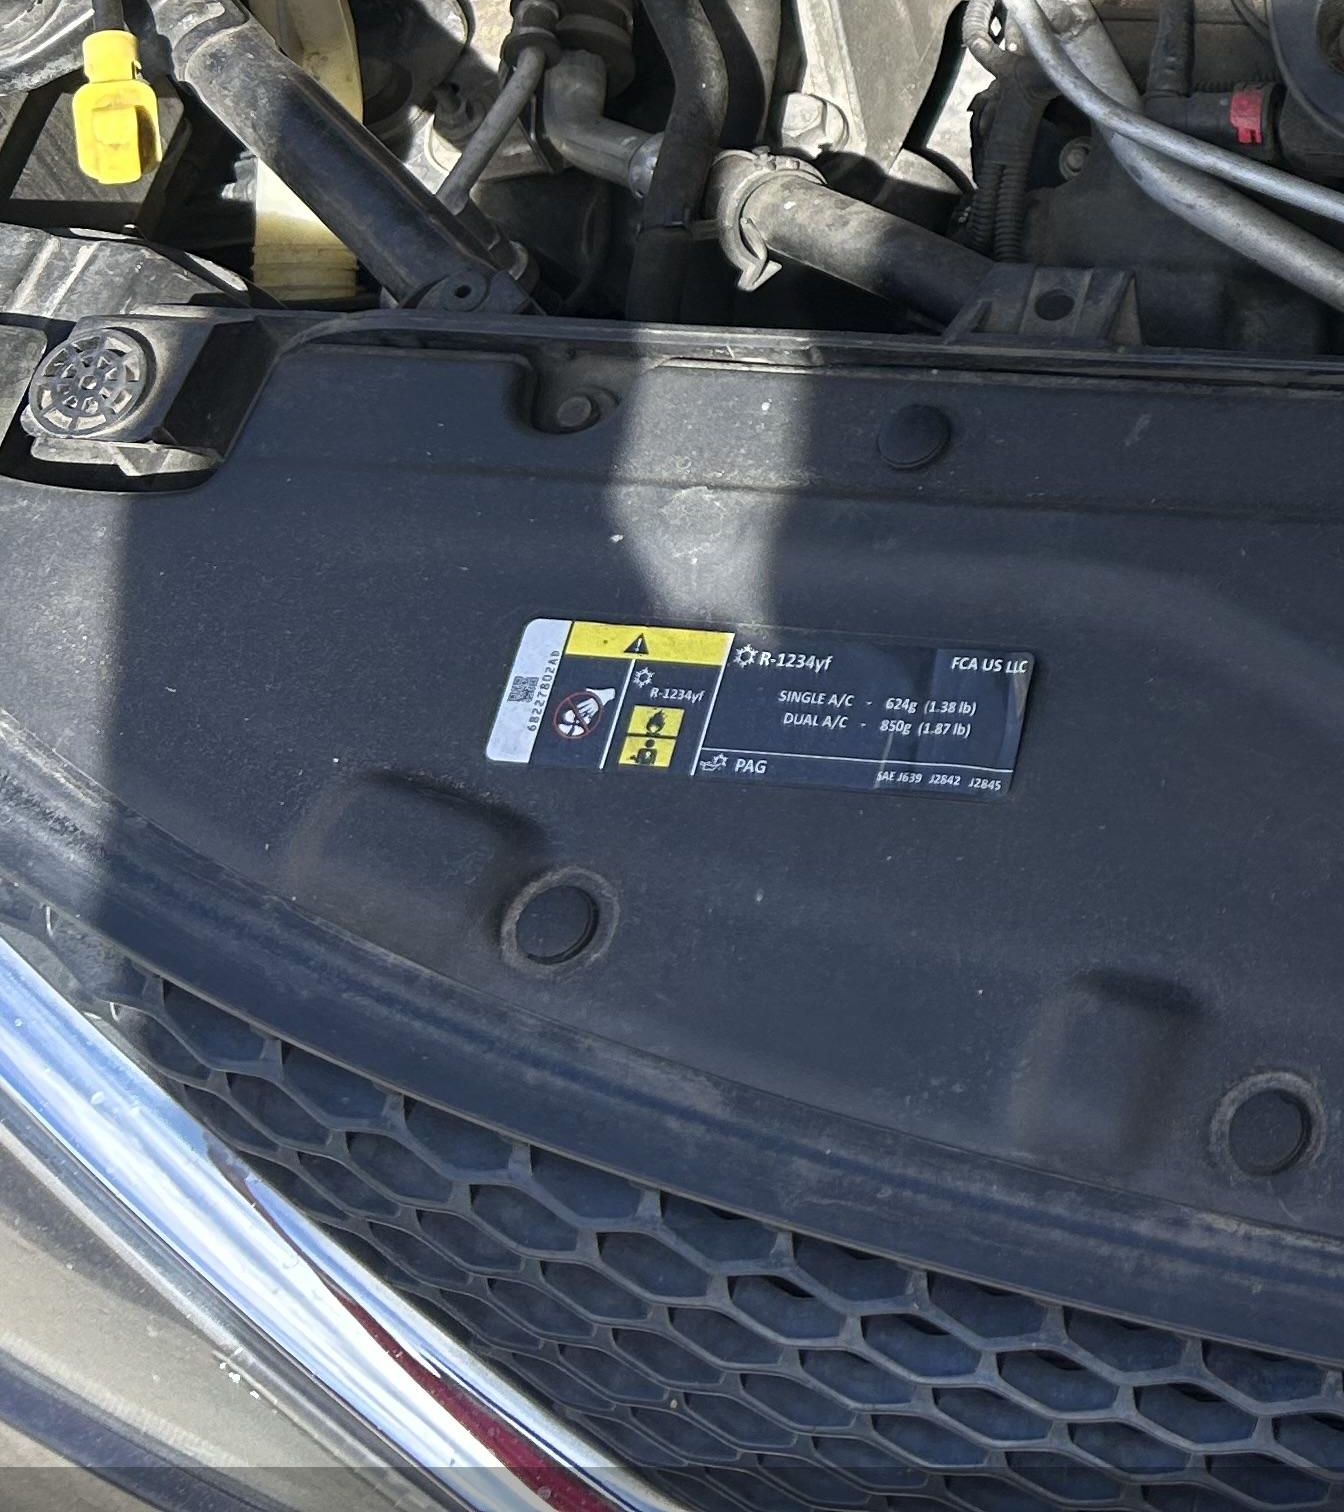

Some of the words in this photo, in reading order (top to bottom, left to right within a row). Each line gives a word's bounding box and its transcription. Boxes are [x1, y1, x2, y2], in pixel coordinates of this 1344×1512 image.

[759, 651, 835, 675] R-1234yf
[951, 656, 978, 672] FCA
[982, 658, 1003, 672] US
[1005, 659, 1029, 674] LLC
[649, 687, 706, 704] R-1234yf
[778, 690, 826, 705] SINGLE
[827, 692, 855, 708] A/C
[885, 697, 918, 715] 624g
[923, 700, 957, 716] (1.38
[958, 700, 977, 717] lb)
[783, 712, 820, 727] DUAL
[822, 714, 849, 730] A/C
[879, 719, 912, 737] 850g
[917, 721, 951, 737] (1.87
[952, 722, 971, 739] lb)
[734, 759, 768, 775] PAG
[876, 770, 896, 783] SAE
[896, 772, 923, 785] J639
[928, 773, 961, 787] J2842
[967, 776, 1002, 791] J2845
